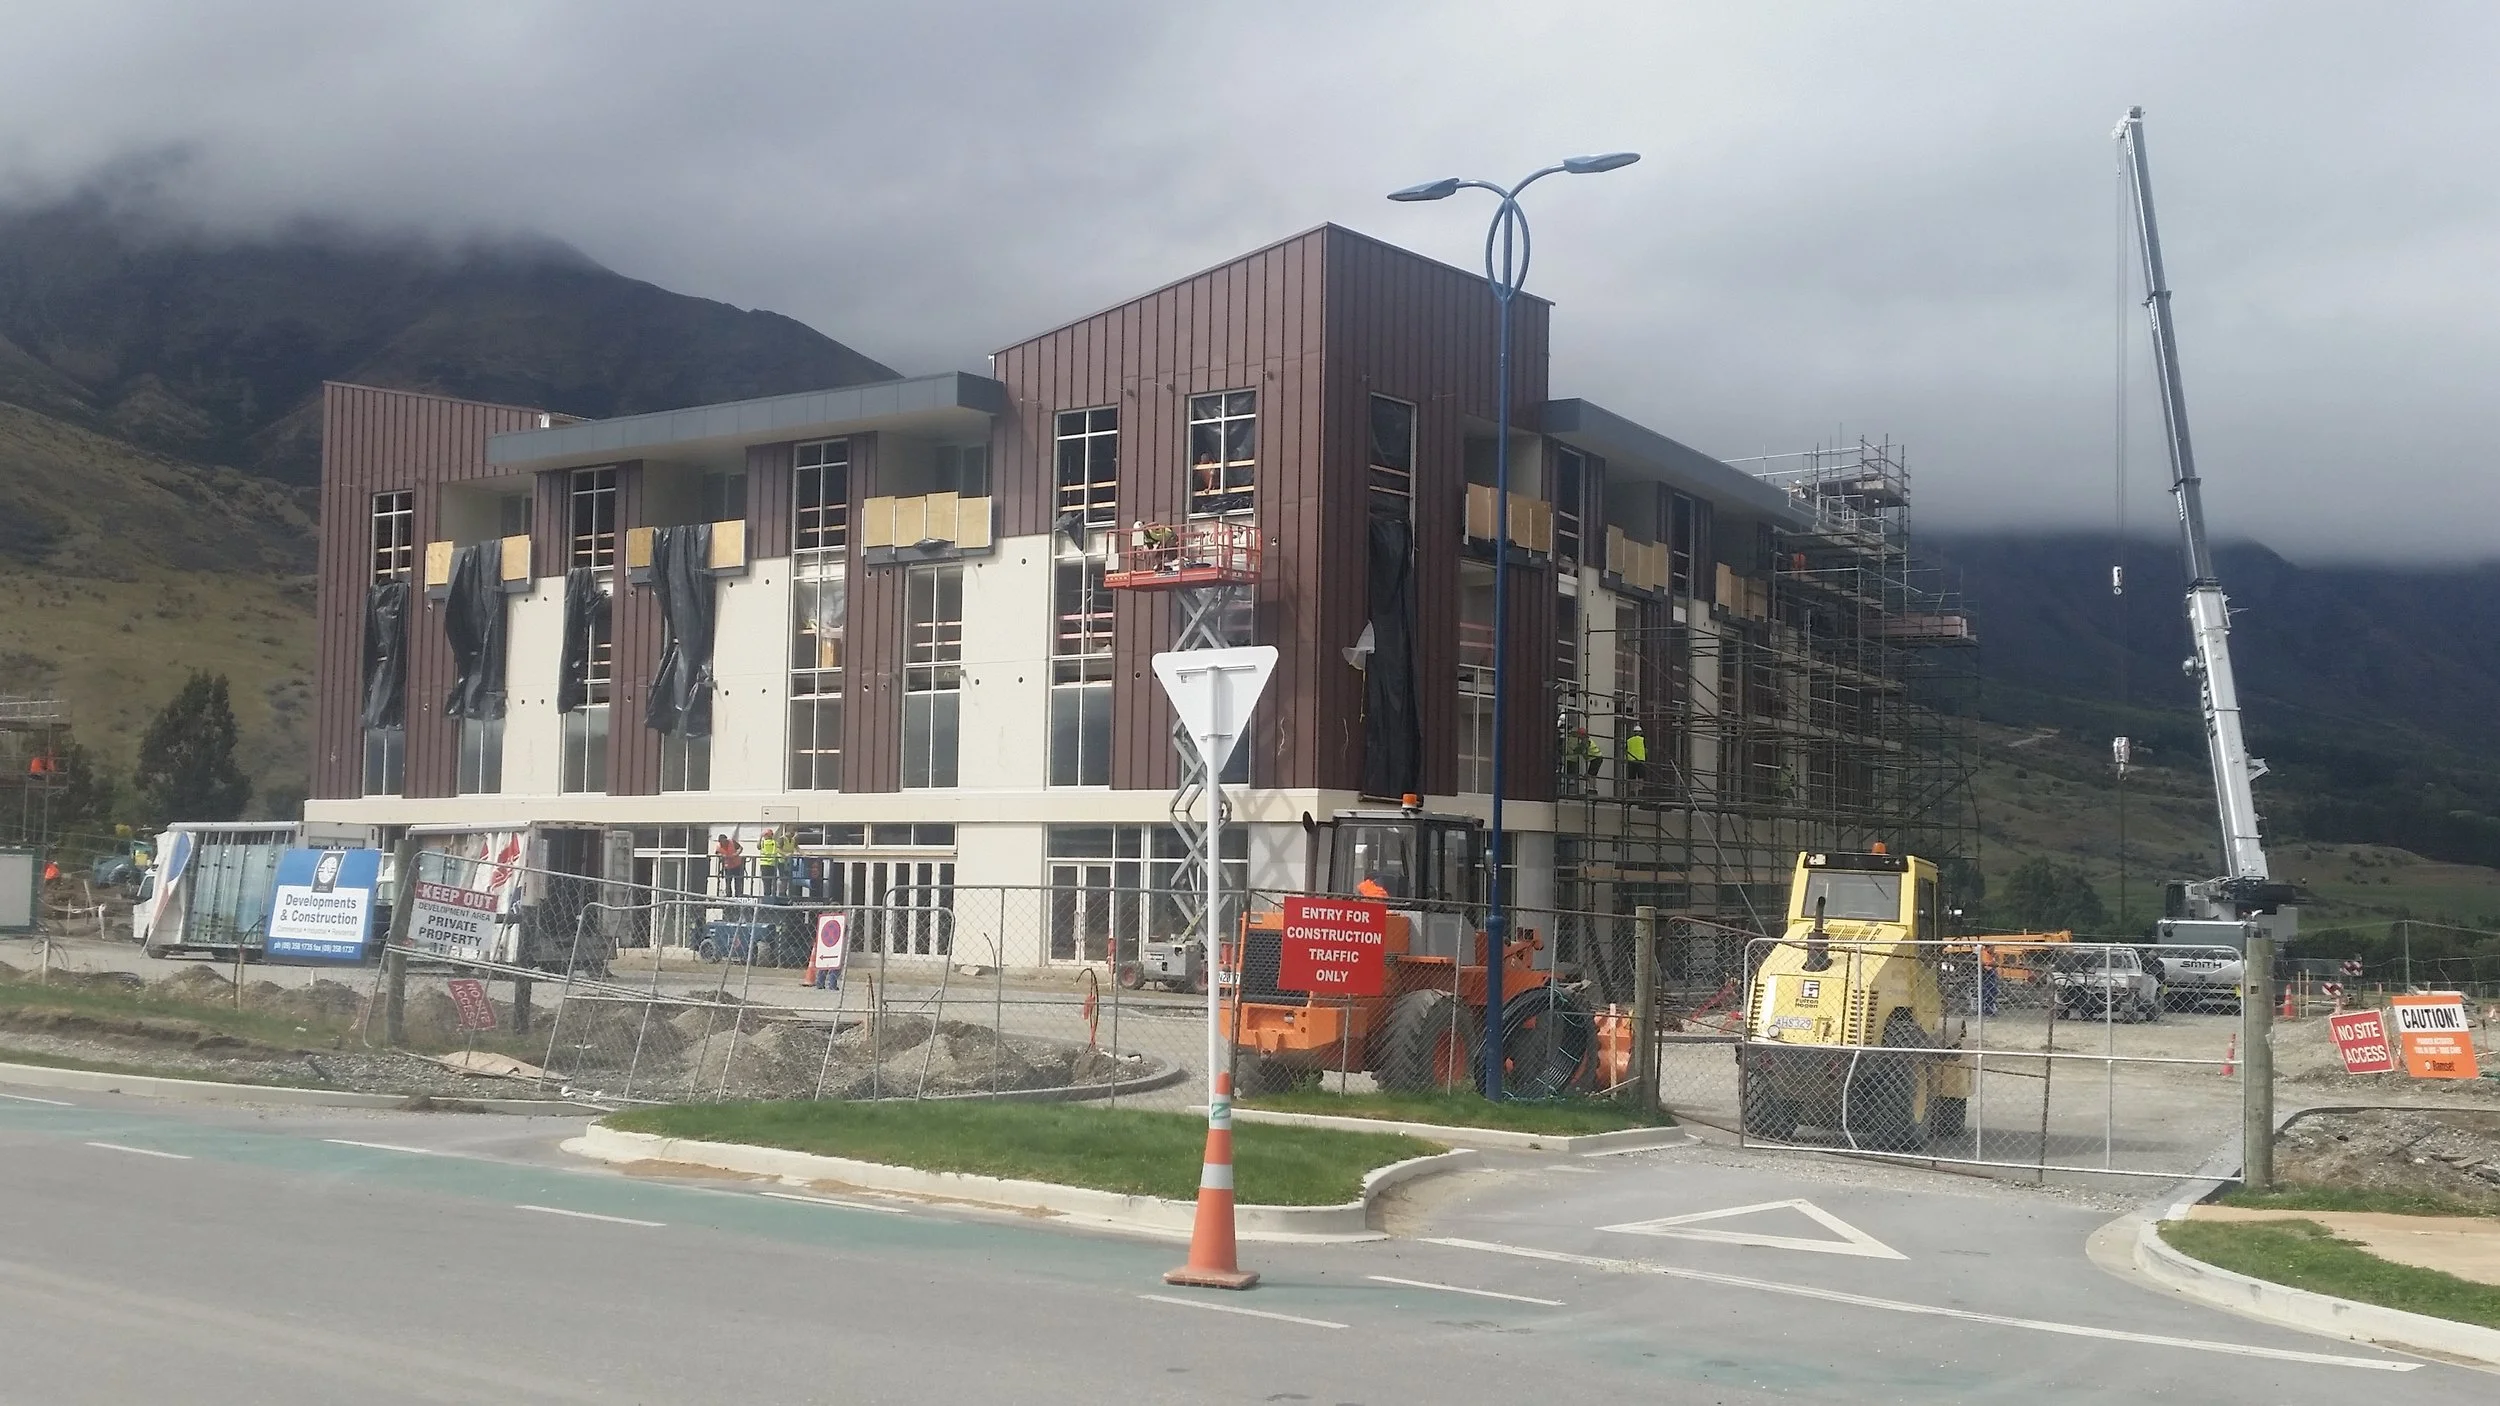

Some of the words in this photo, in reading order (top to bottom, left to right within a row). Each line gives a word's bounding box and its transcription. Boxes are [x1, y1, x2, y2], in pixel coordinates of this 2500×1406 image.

[286, 894, 357, 910] Developments
[421, 884, 460, 903] KEEP
[463, 892, 493, 909] OUT
[280, 909, 288, 921] &
[291, 910, 358, 925] Construction
[418, 902, 470, 917] DEVELOPMENT
[472, 911, 491, 922] AREA
[1301, 906, 1342, 922] ENTRY
[1346, 910, 1370, 924] FOR
[428, 915, 478, 933] PRIVATE
[418, 927, 482, 947] PROPERTY
[1286, 926, 1382, 945] CONSTRUCTION
[1308, 948, 1359, 963] TRAFFIC
[1315, 969, 1349, 983] ONLY
[466, 983, 480, 998] NO
[2401, 1007, 2460, 1029] CAUTION!
[2337, 1025, 2354, 1041] NO
[2354, 1021, 2381, 1040] SITE
[2345, 1045, 2387, 1064] ACCESS
